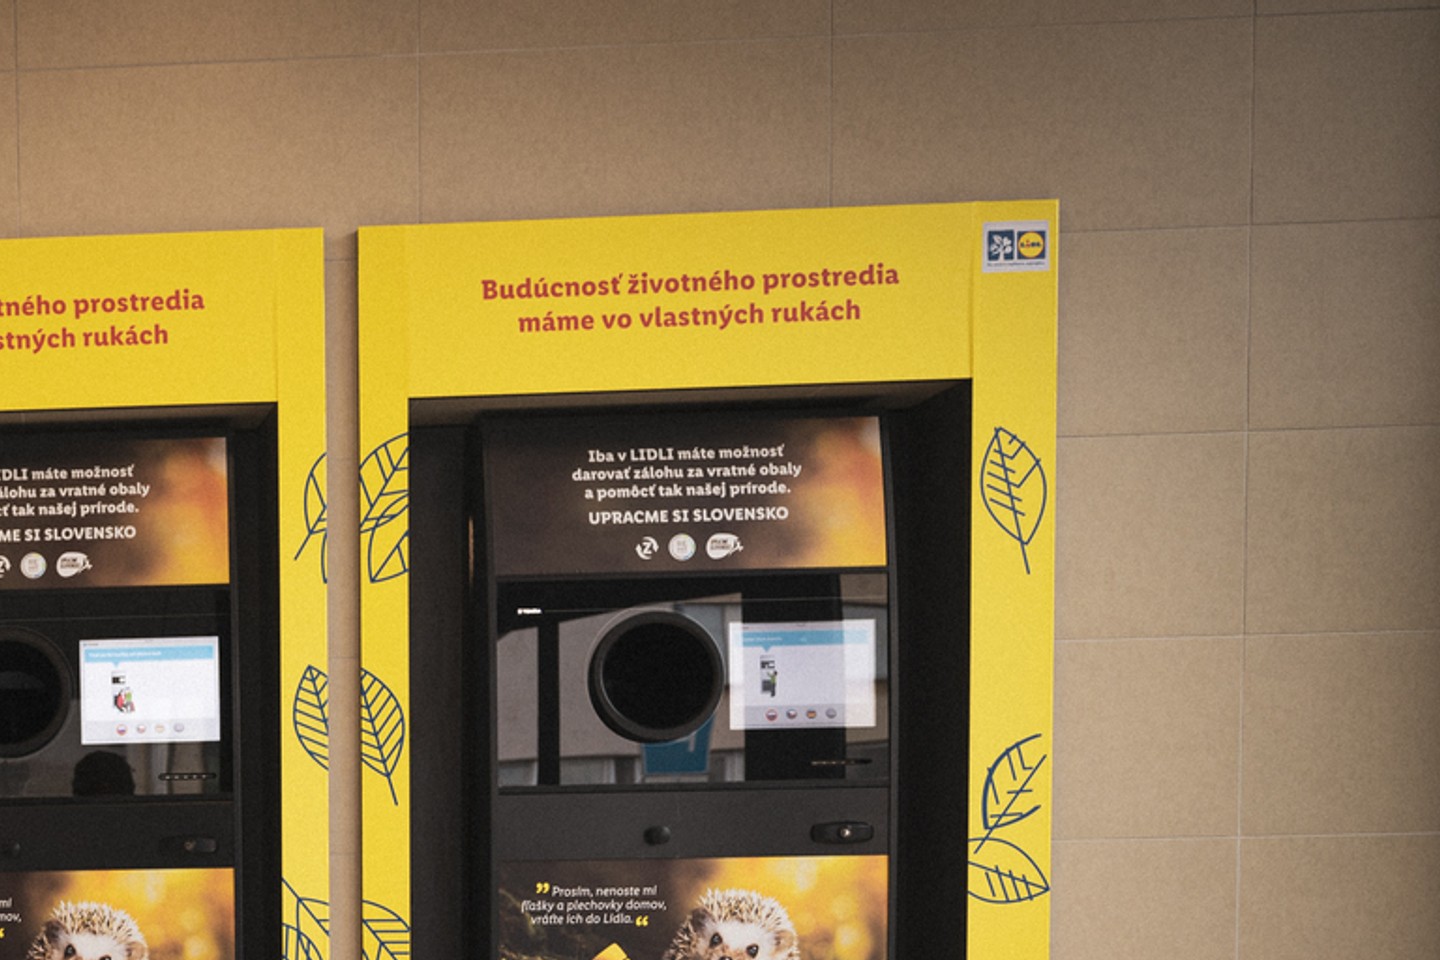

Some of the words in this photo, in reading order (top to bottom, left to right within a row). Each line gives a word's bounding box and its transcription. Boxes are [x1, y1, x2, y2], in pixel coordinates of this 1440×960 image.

[481, 273, 623, 301] Budúcnosť
[627, 269, 756, 295] životného
[762, 262, 900, 295] prostredia
[73, 288, 206, 320] prostredia
[518, 311, 595, 332] máme
[601, 312, 633, 329] vo
[639, 303, 764, 331] vlastných
[771, 298, 861, 323] rukách
[82, 323, 169, 348] rukách
[588, 450, 614, 463] Iba
[617, 452, 627, 461] v
[630, 448, 674, 461] LIDLI
[677, 446, 715, 459] máte
[718, 443, 785, 459] možnosť
[32, 467, 68, 480] máte
[71, 463, 135, 479] možnosť
[571, 466, 631, 482] darovať
[634, 465, 684, 479] zálohu
[687, 468, 704, 478] za
[707, 463, 756, 477] vratné
[759, 462, 802, 478] obaly
[40, 487, 57, 498] za
[59, 482, 106, 497] vratné
[109, 482, 150, 498] obaly
[585, 488, 594, 499] a
[596, 483, 656, 502] pomôcť
[658, 483, 683, 497] tak
[686, 481, 726, 498] našej
[729, 480, 792, 498] prírode.
[12, 502, 36, 517] tak
[39, 501, 78, 518] našej
[80, 500, 140, 518] prírode.
[588, 509, 669, 525] UPRACME
[672, 509, 689, 522] SI
[693, 506, 790, 522] SLOVENSKO
[24, 528, 41, 542] SI
[44, 525, 137, 541] SLOVENSKO
[642, 884, 658, 896] mi
[556, 901, 564, 910] a
[585, 912, 601, 924] do
